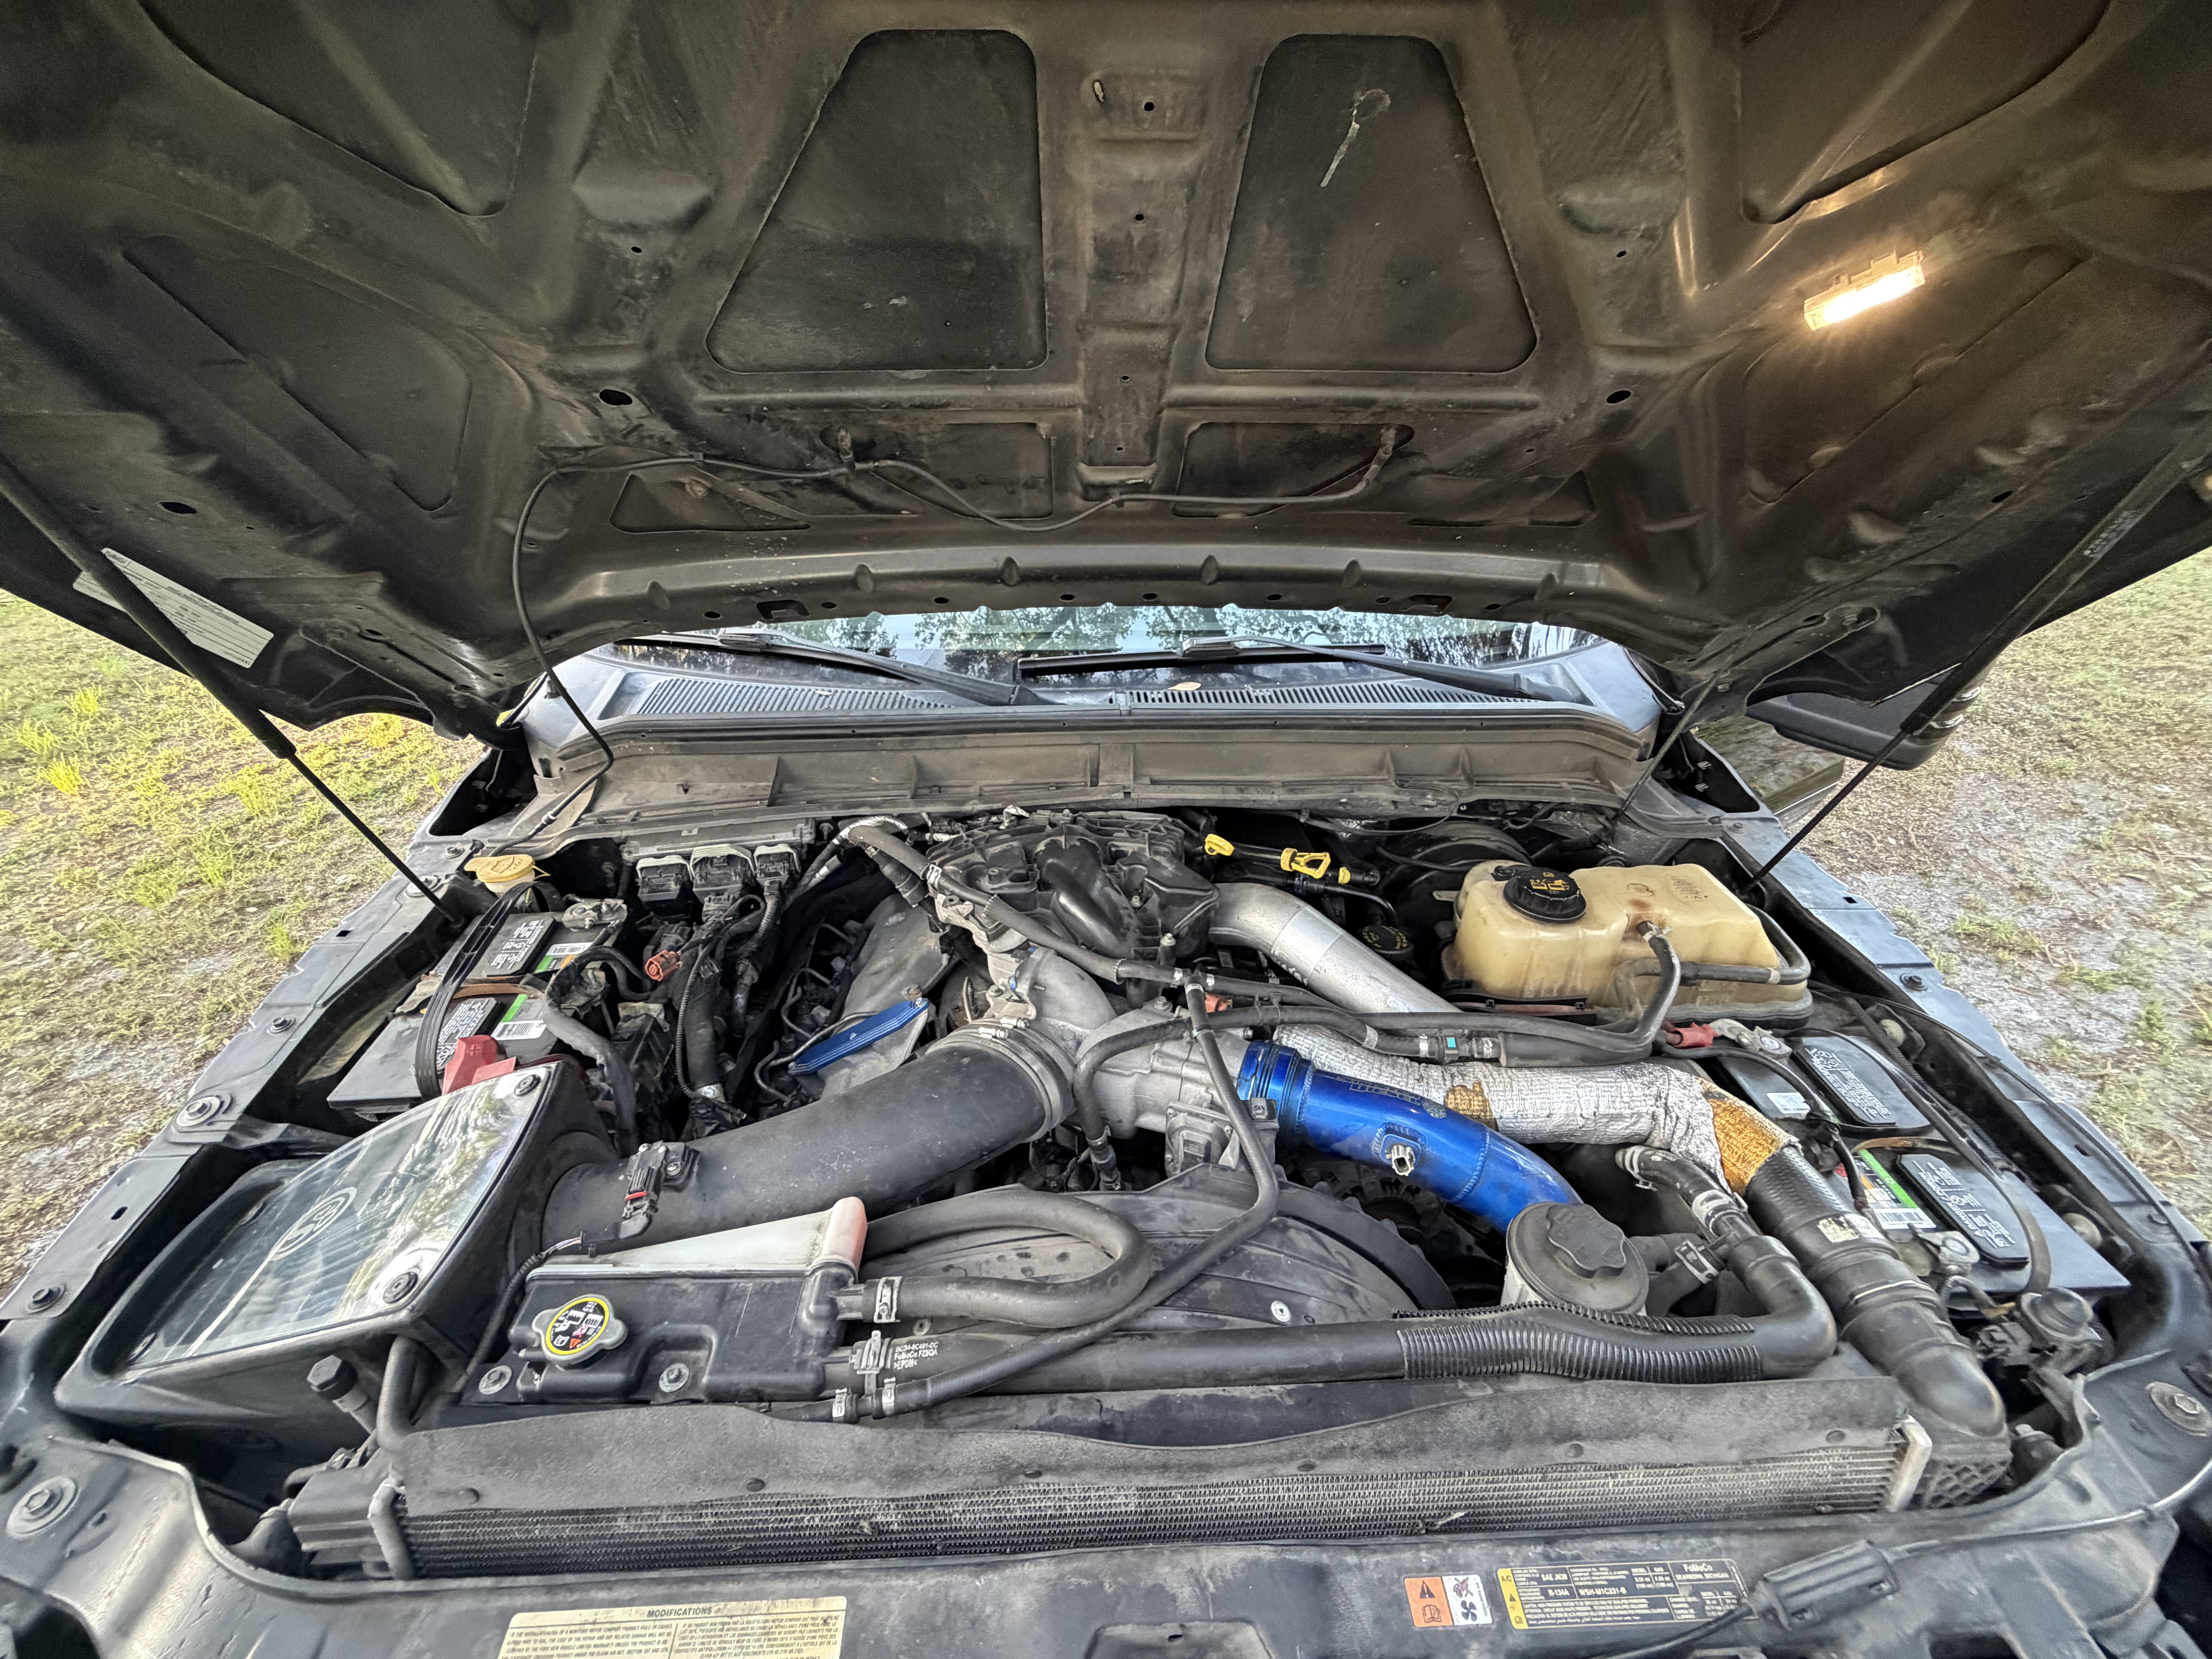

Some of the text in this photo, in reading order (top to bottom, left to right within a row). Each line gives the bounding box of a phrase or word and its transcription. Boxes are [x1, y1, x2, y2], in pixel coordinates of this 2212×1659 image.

[1918, 1172, 1944, 1196] POISON
[1946, 1202, 1976, 1230] DANGER
[646, 1606, 713, 1618] MODIFICATIONS
